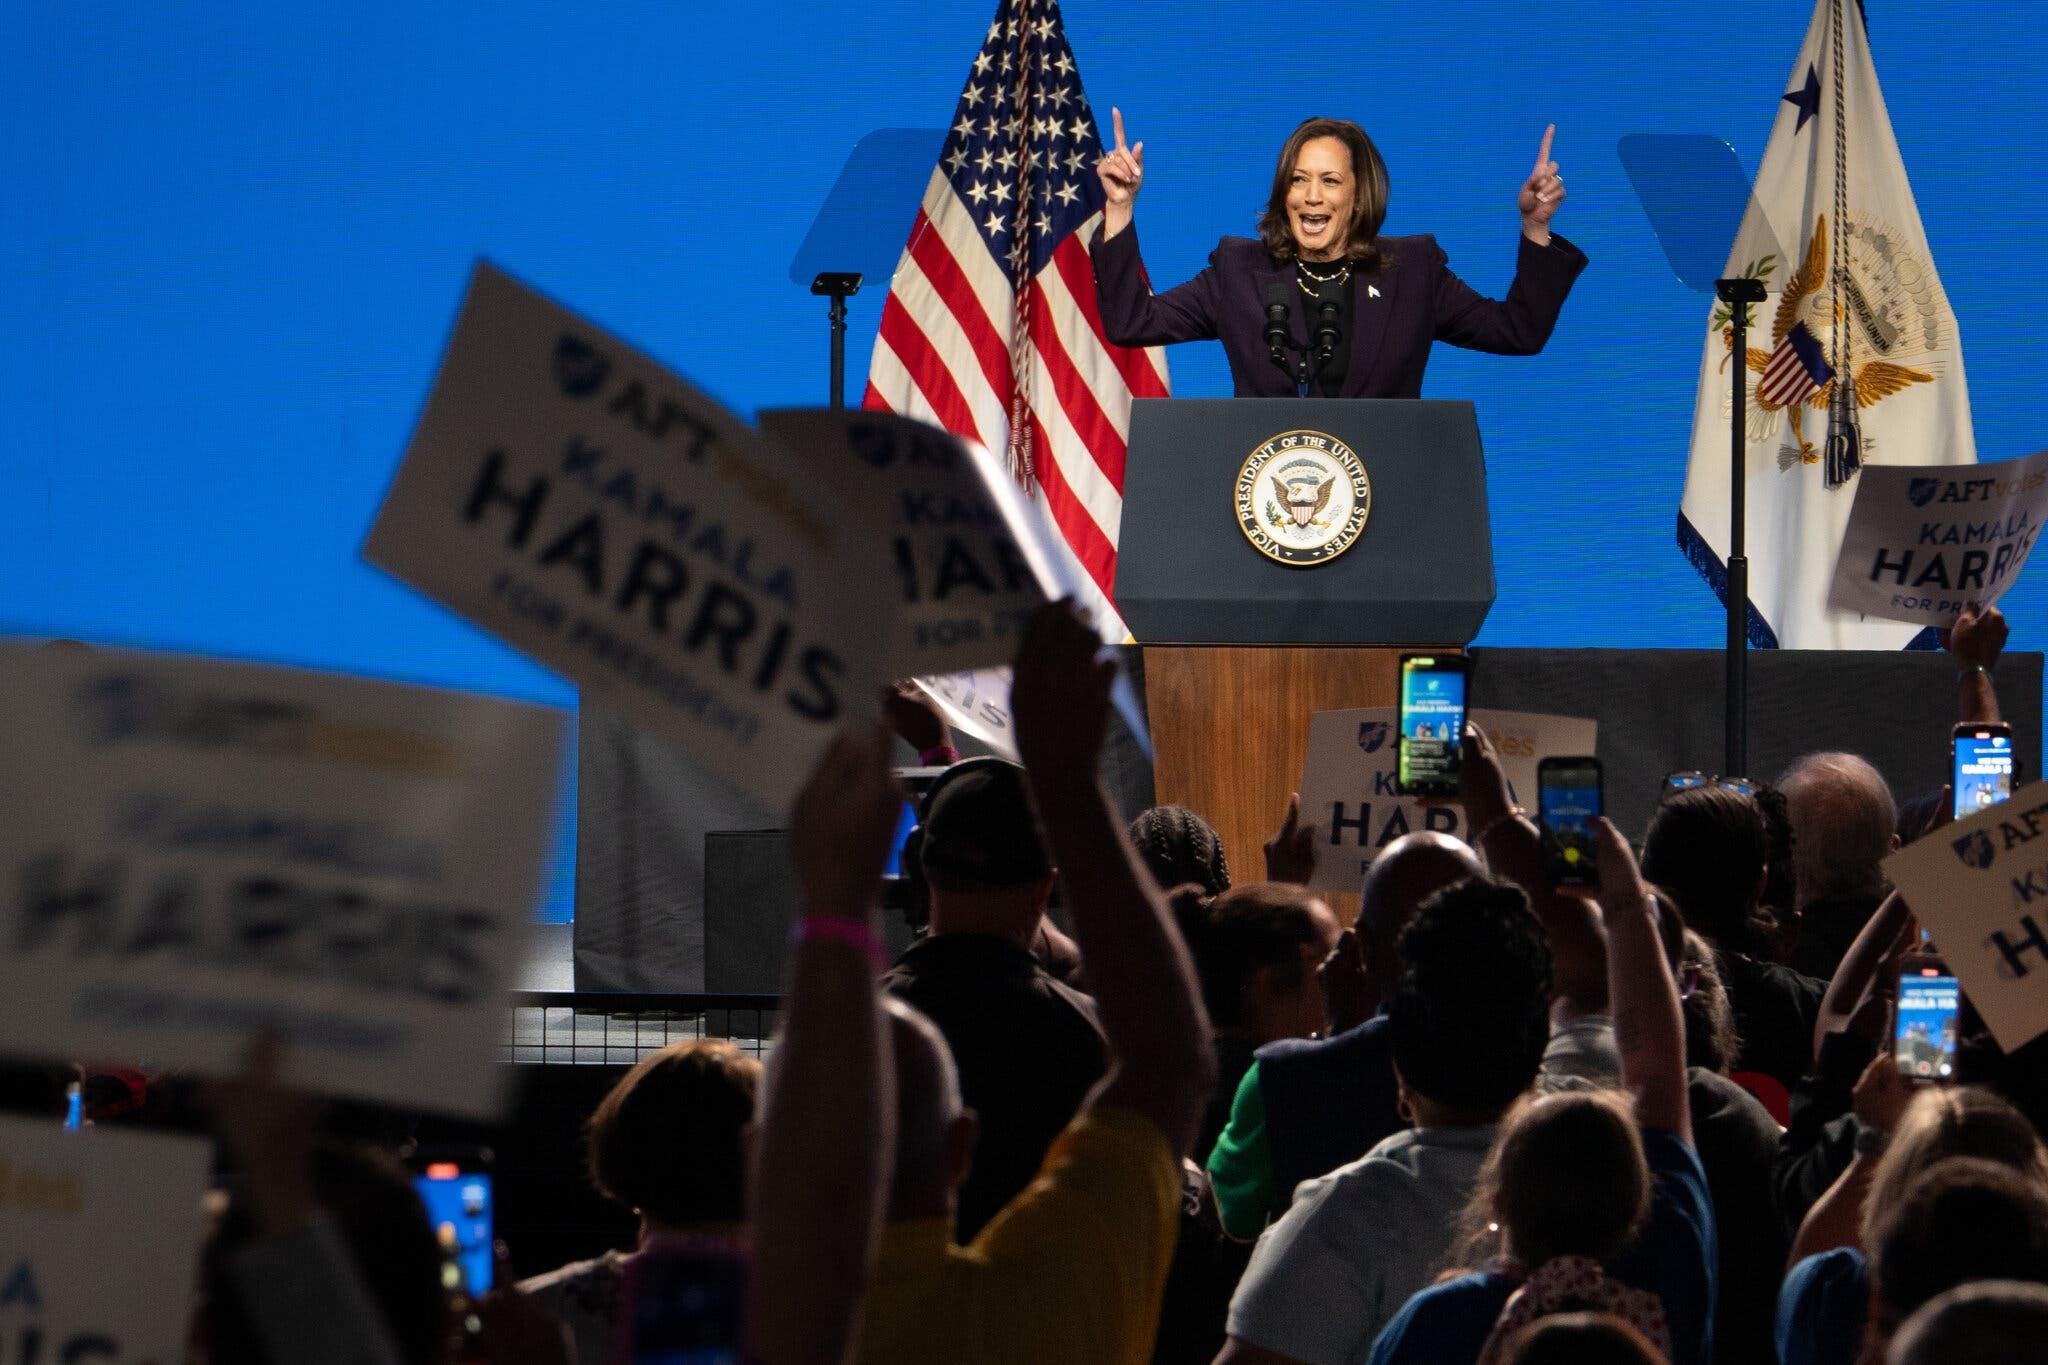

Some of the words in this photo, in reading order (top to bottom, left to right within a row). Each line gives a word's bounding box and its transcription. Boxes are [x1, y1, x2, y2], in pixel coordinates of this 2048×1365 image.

[1866, 323, 1890, 351] UNUM
[1281, 436, 1298, 448] OF
[1301, 435, 1327, 448] THE
[1239, 443, 1275, 521] PRESIDENT
[1331, 443, 1367, 498] UNITED
[560, 434, 801, 605] KAMALA
[1323, 507, 1365, 555] STATES
[1918, 510, 2029, 545] KAMALA
[1248, 525, 1280, 556] VICE
[1870, 523, 2037, 590] HARRIS
[461, 449, 849, 724] HARRIS
[1890, 594, 1931, 612] FOR
